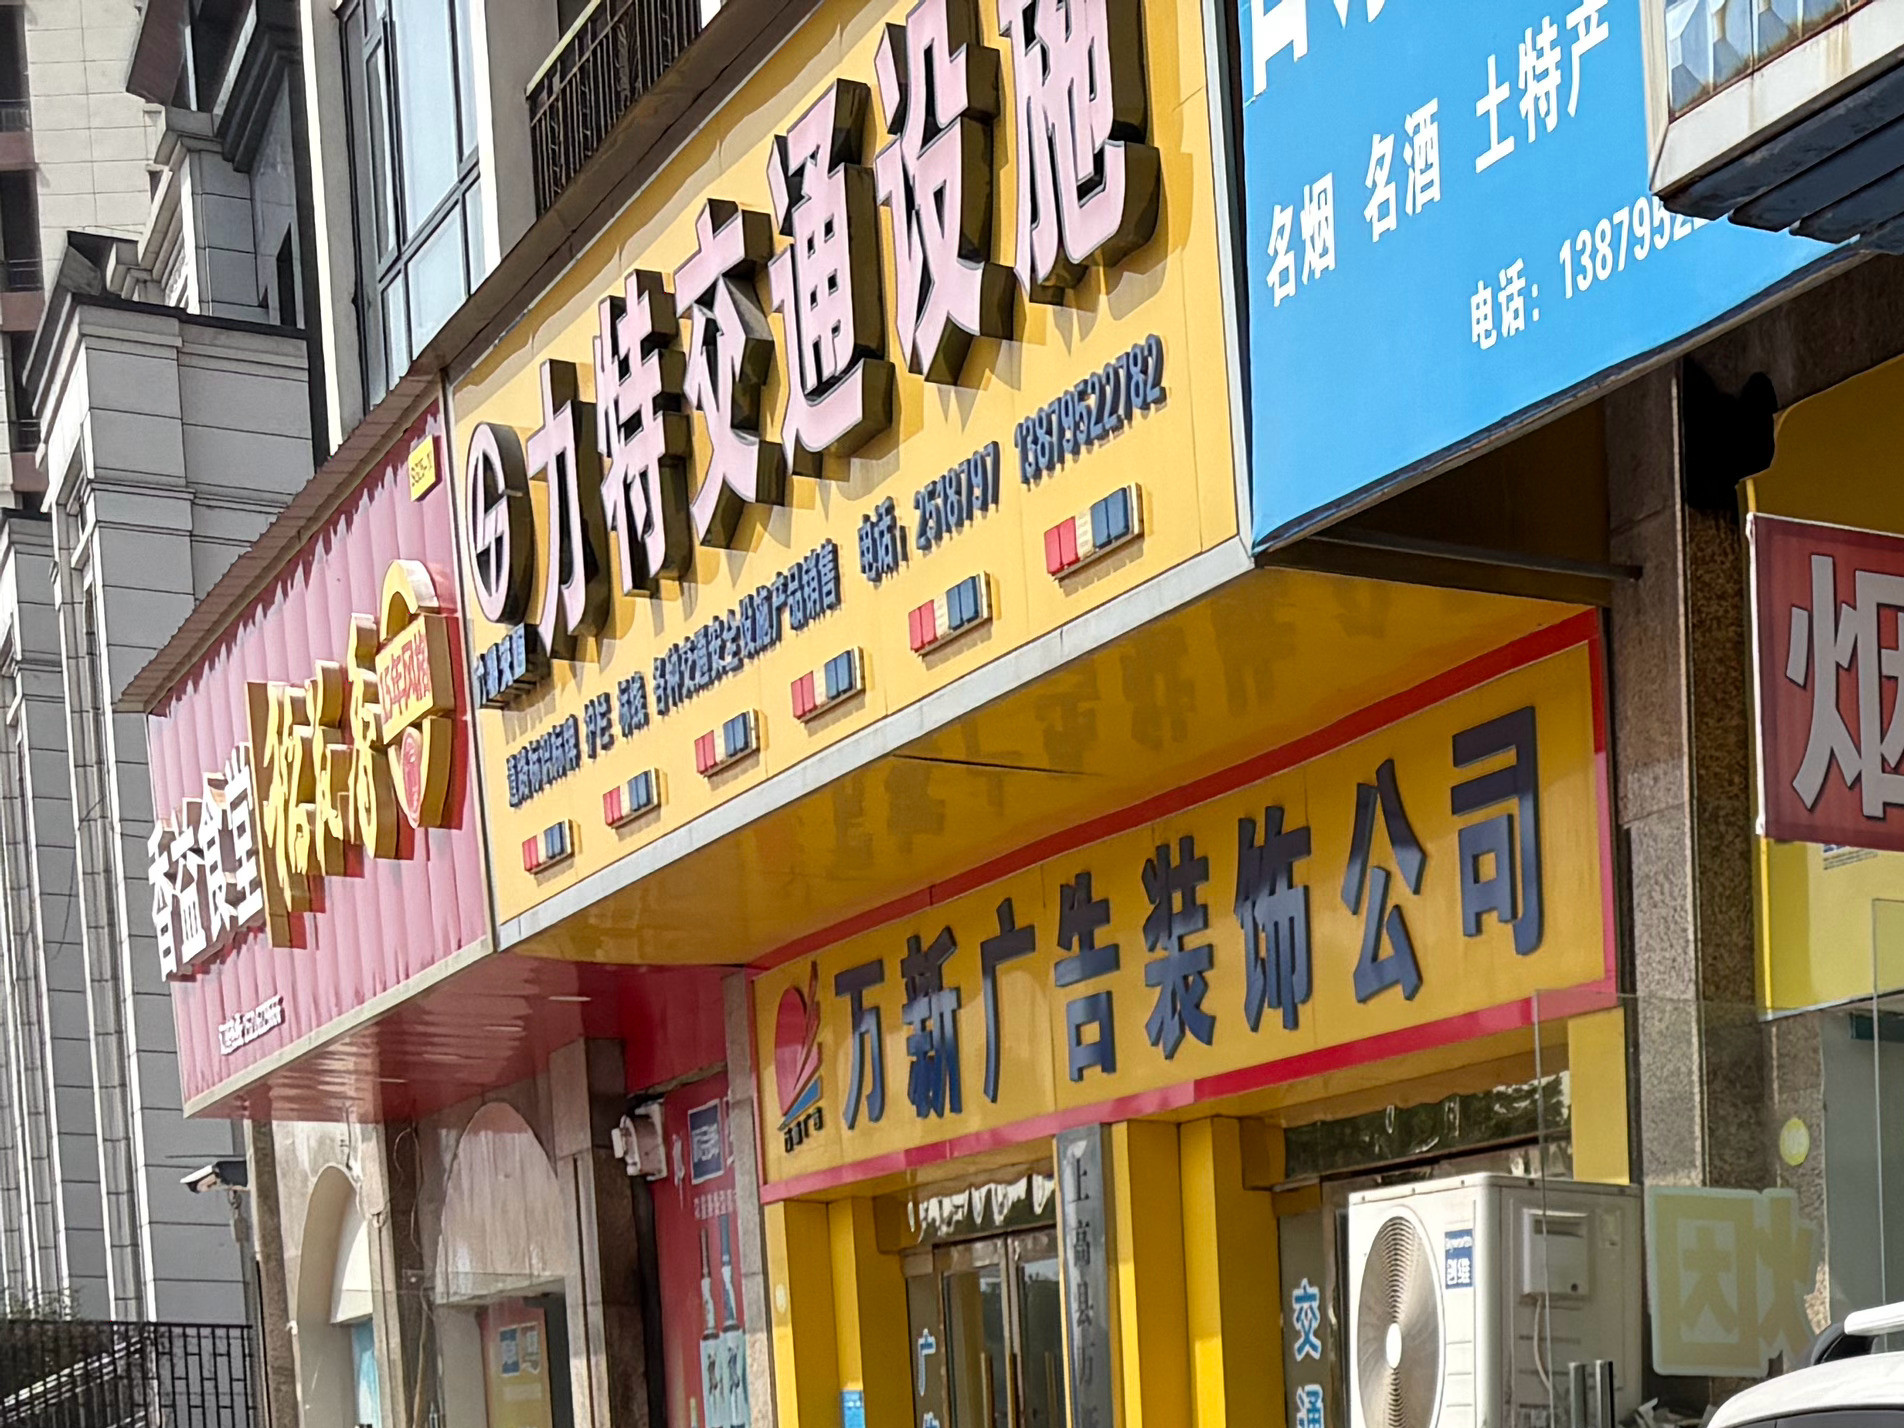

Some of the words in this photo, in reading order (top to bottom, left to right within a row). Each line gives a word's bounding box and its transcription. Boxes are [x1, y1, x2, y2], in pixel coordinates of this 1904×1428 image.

[1266, 173, 1336, 307] 名烟
[1363, 97, 1441, 243] 名酒
[1474, 0, 1611, 174] 土特产
[527, 0, 1157, 640] 力特交通设施
[913, 440, 1001, 552] 2518797
[1014, 333, 1169, 486] 13879522782
[148, 742, 264, 982] 香益食堂
[833, 704, 1543, 1132] 万新广告装饰公司
